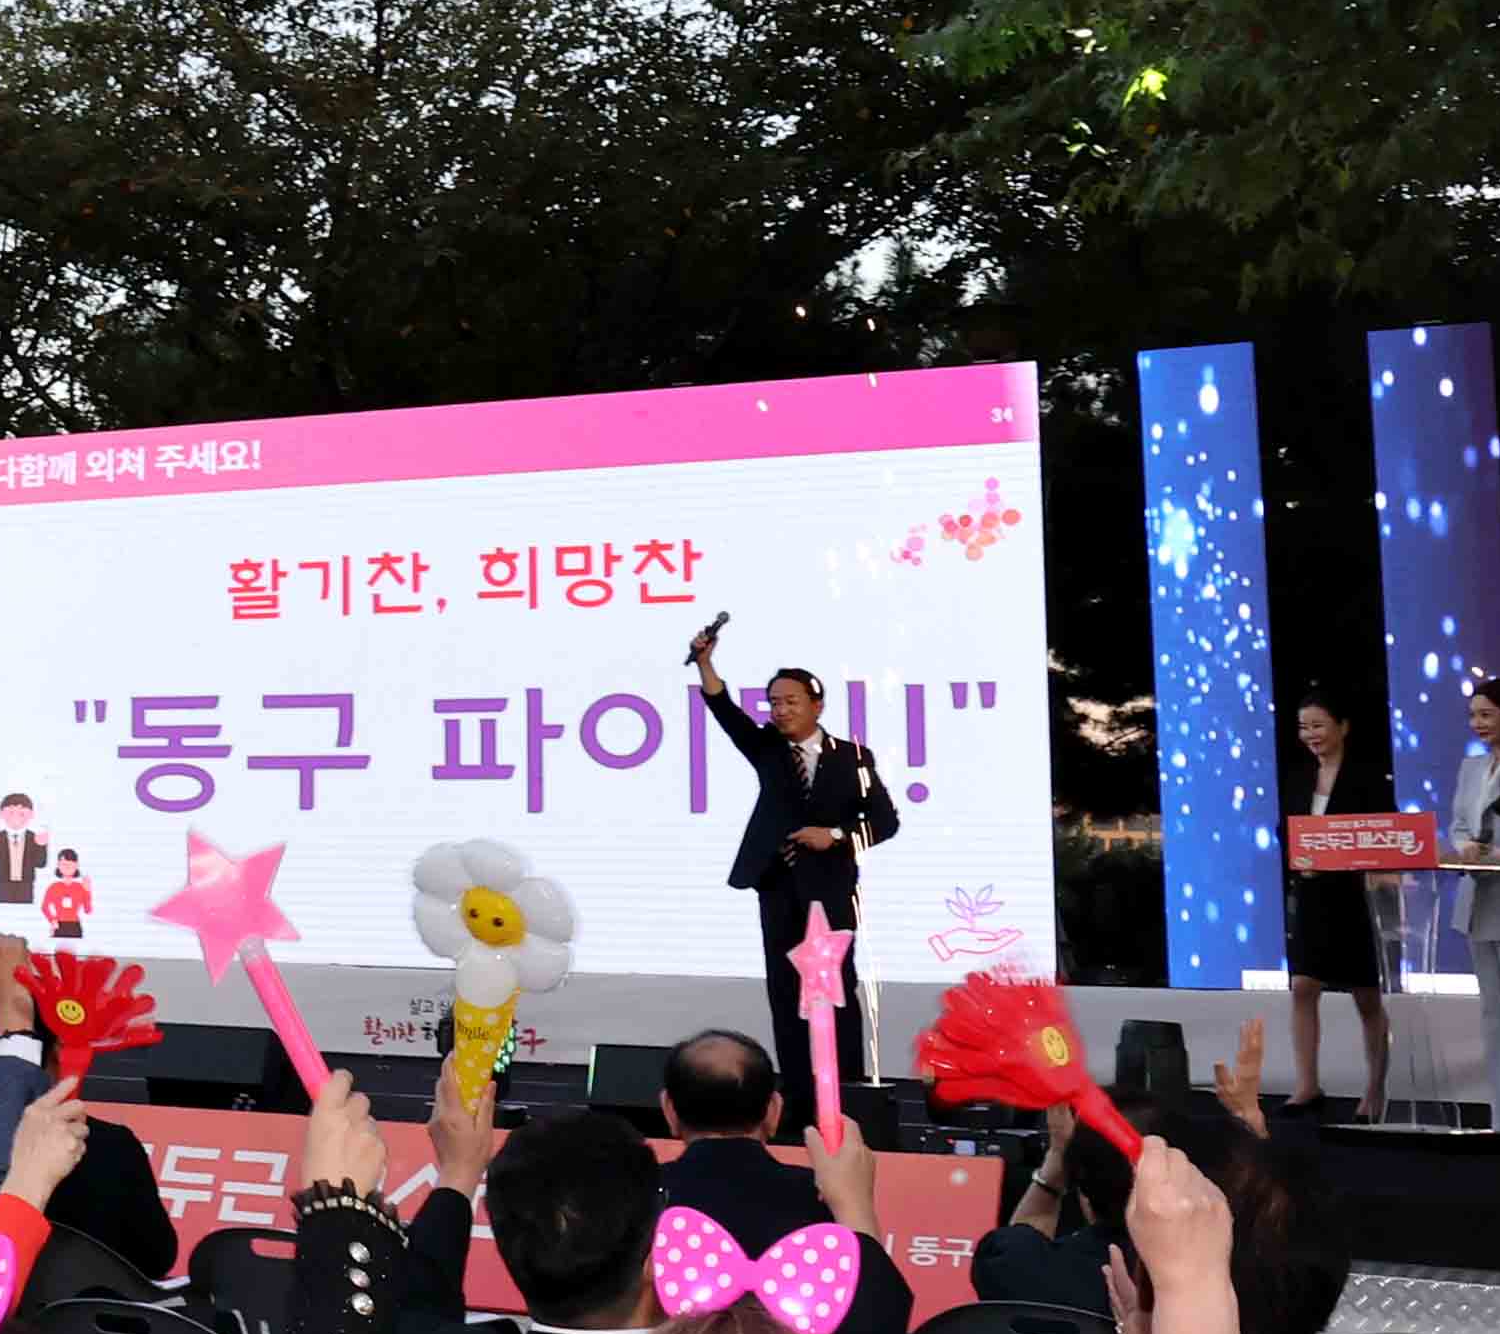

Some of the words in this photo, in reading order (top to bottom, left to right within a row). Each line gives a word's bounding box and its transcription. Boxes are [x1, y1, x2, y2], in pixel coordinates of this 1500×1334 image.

[85, 445, 146, 484] 외쳐
[154, 439, 262, 479] 주세요!
[226, 557, 448, 620] 활기찬,
[476, 538, 704, 610] 희망찬
[73, 693, 372, 814] "동구
[431, 679, 998, 814] 파이!"
[906, 1235, 975, 1268] 동구
